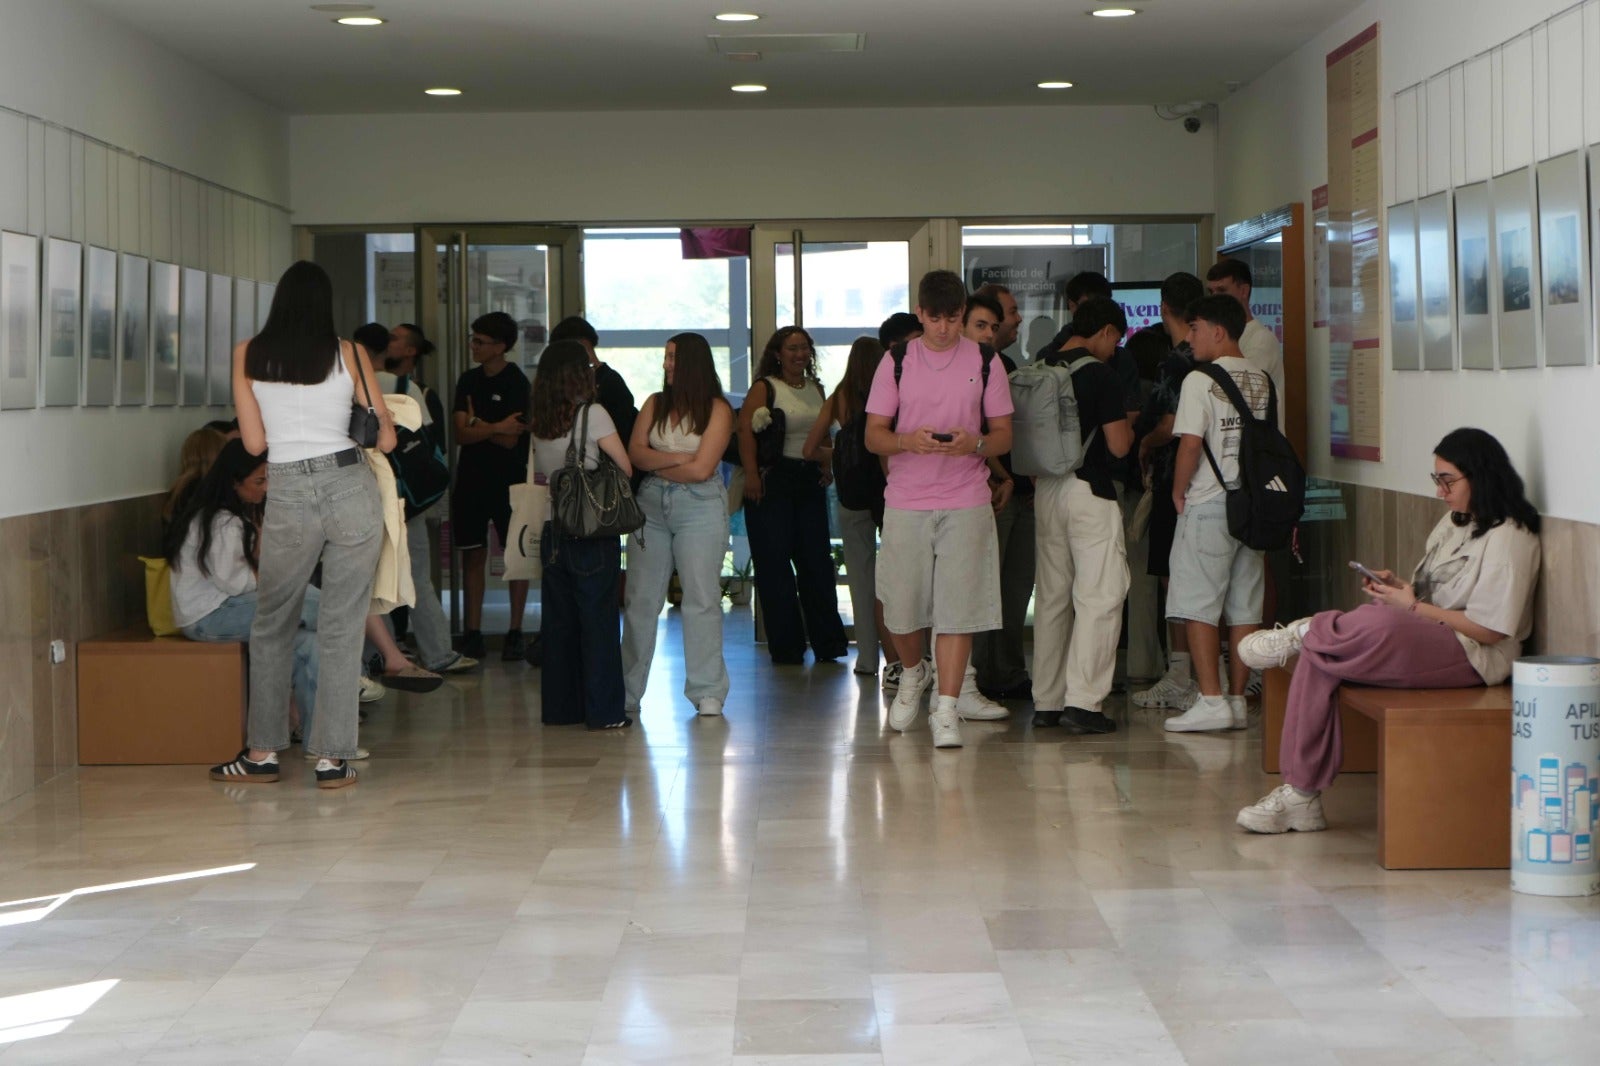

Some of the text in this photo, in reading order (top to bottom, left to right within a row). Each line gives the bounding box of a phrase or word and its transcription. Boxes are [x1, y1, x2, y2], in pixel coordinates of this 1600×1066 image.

[981, 268, 1044, 278] Facultad de
[981, 281, 1056, 291] Cunicación
[1570, 723, 1600, 741] TUS
